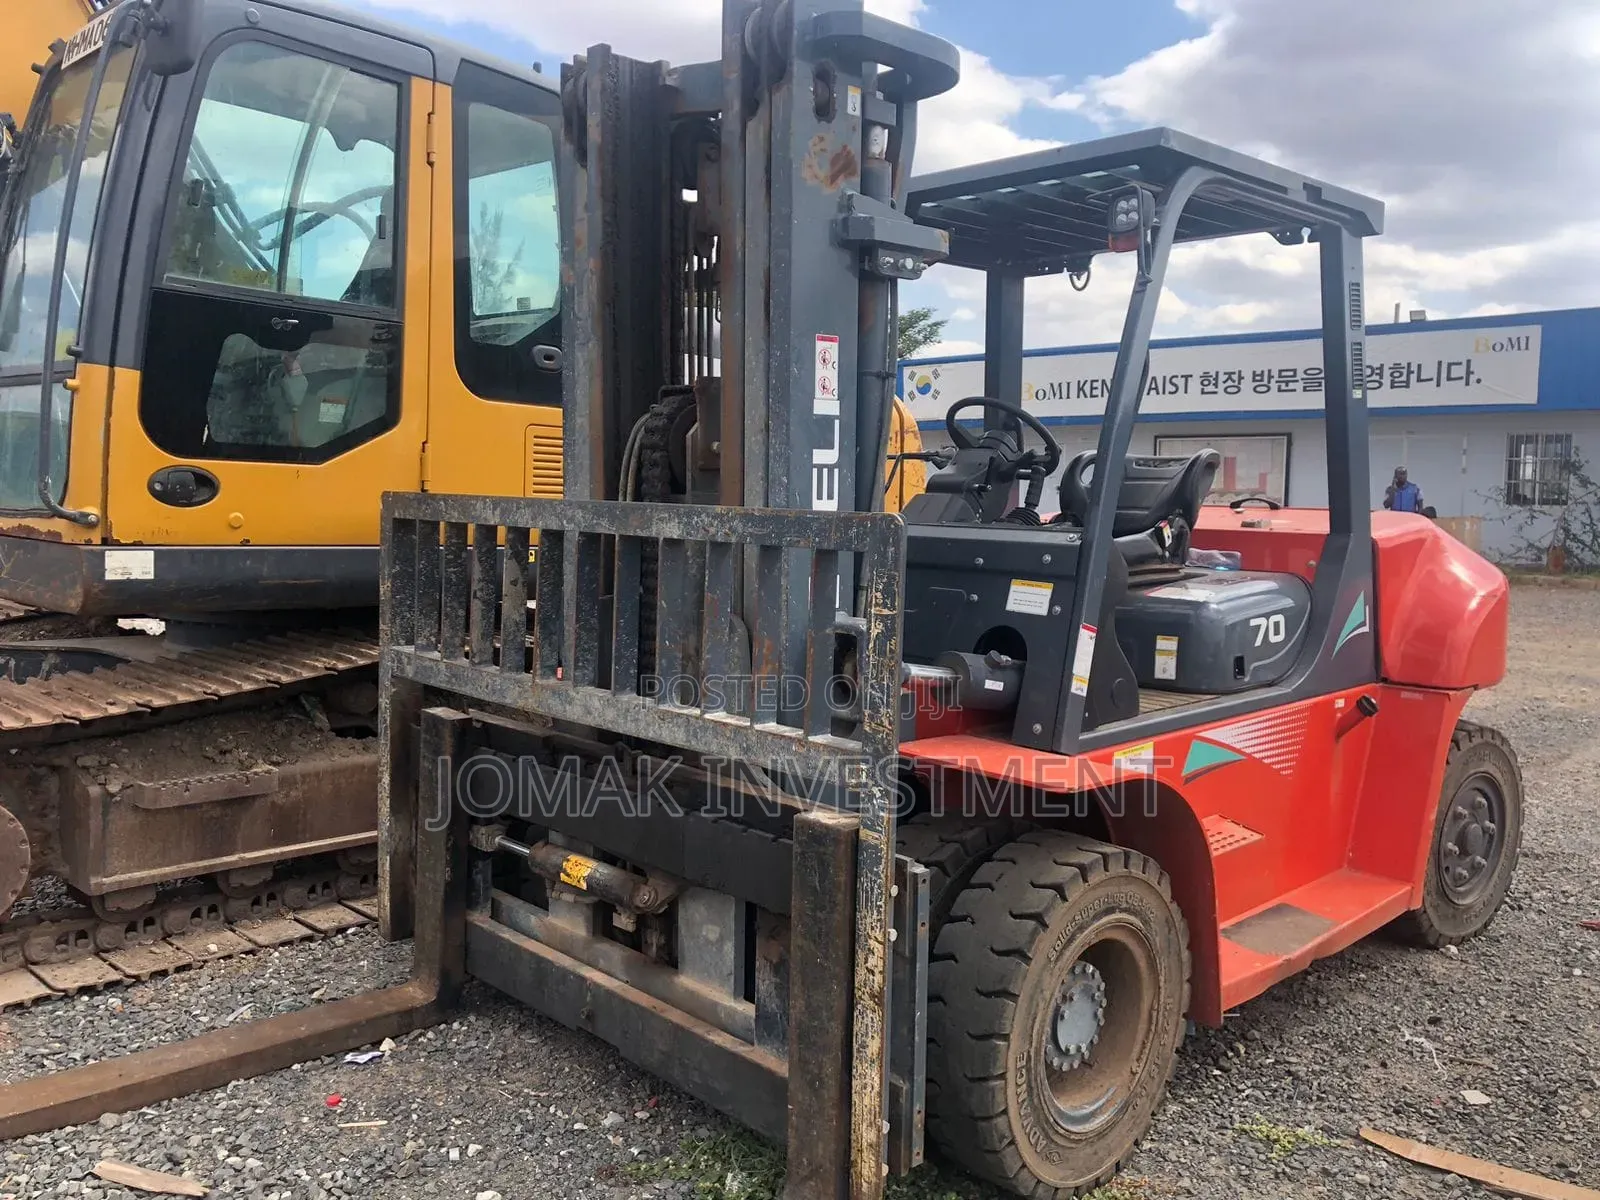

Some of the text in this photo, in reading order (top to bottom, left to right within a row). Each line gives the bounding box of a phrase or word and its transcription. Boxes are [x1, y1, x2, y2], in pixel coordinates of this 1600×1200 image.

[1474, 335, 1530, 353] BoMI
[1199, 370, 1245, 396] 현장
[1251, 366, 1326, 394] 방문을
[1364, 358, 1482, 391] 영합니다.
[1249, 613, 1285, 647] 70
[1015, 1052, 1047, 1153] ADVANCE
